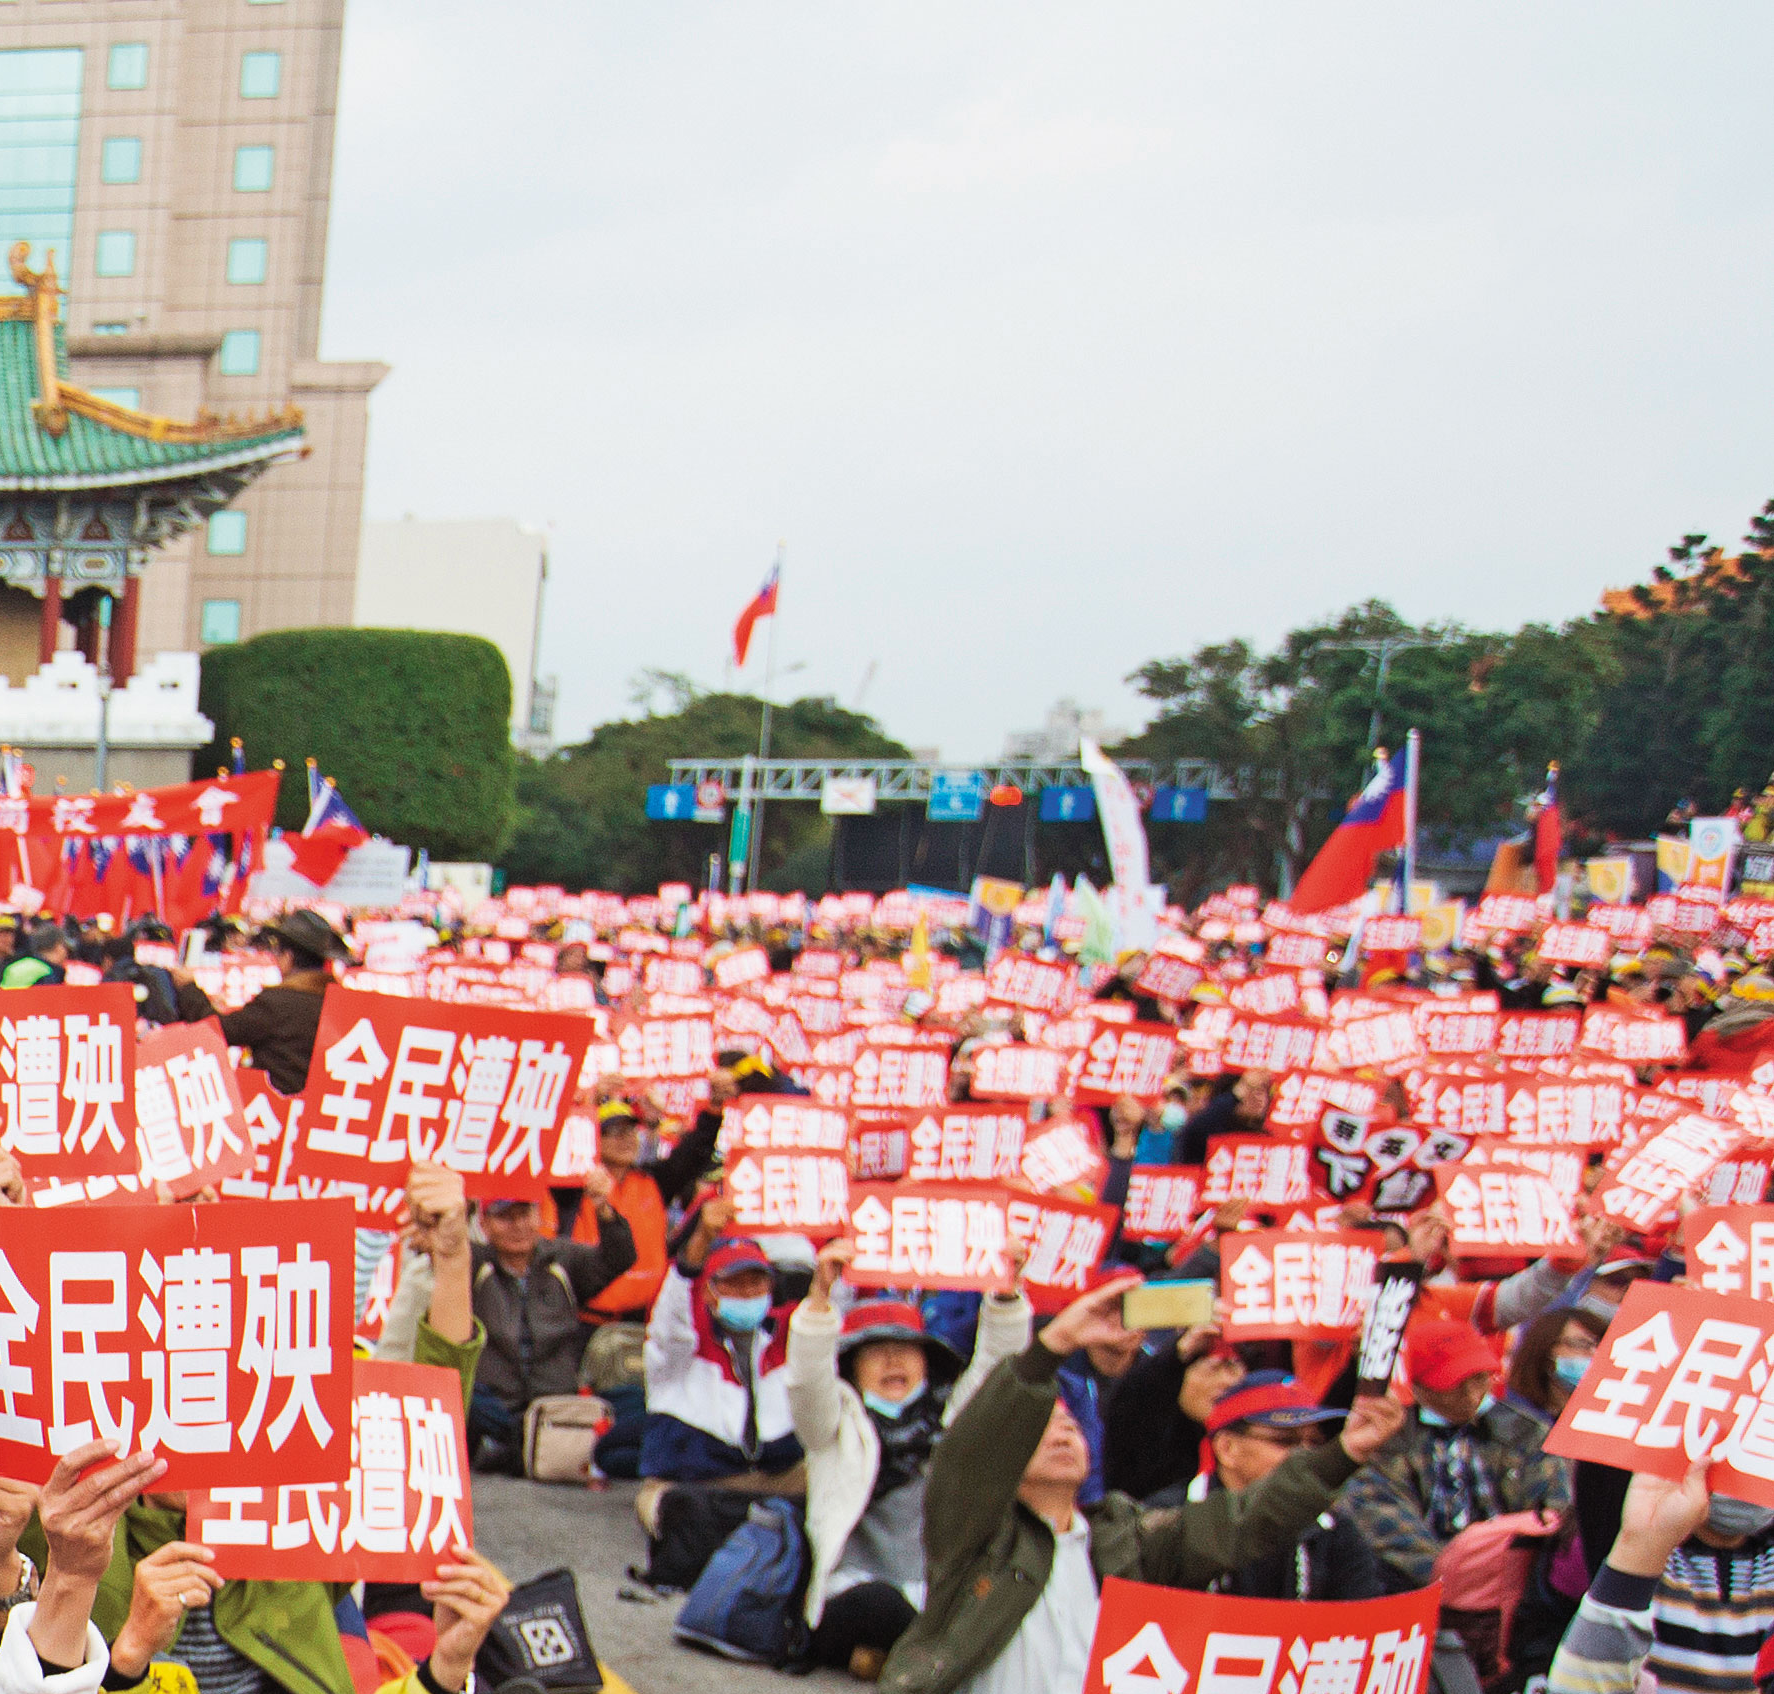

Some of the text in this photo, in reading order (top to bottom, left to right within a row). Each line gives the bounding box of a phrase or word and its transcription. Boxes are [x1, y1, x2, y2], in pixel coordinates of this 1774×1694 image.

[619, 1019, 712, 1075] 全民遭殃
[854, 1051, 946, 1105] 全民遭殃
[1082, 1030, 1172, 1093] 全民遭殃
[307, 1016, 572, 1177] 全民遭殃
[743, 1106, 847, 1148] 全民遭殃
[1509, 1090, 1623, 1142] 全民遭殃
[910, 1115, 1025, 1178] 全民遭殃
[1206, 1141, 1309, 1203] 全民遭殃
[730, 1155, 848, 1223] 全民遭殃
[1446, 1170, 1574, 1246] 全民遭殃
[854, 1197, 1007, 1276] 全民遭殃
[1229, 1240, 1383, 1325] 全民遭殃
